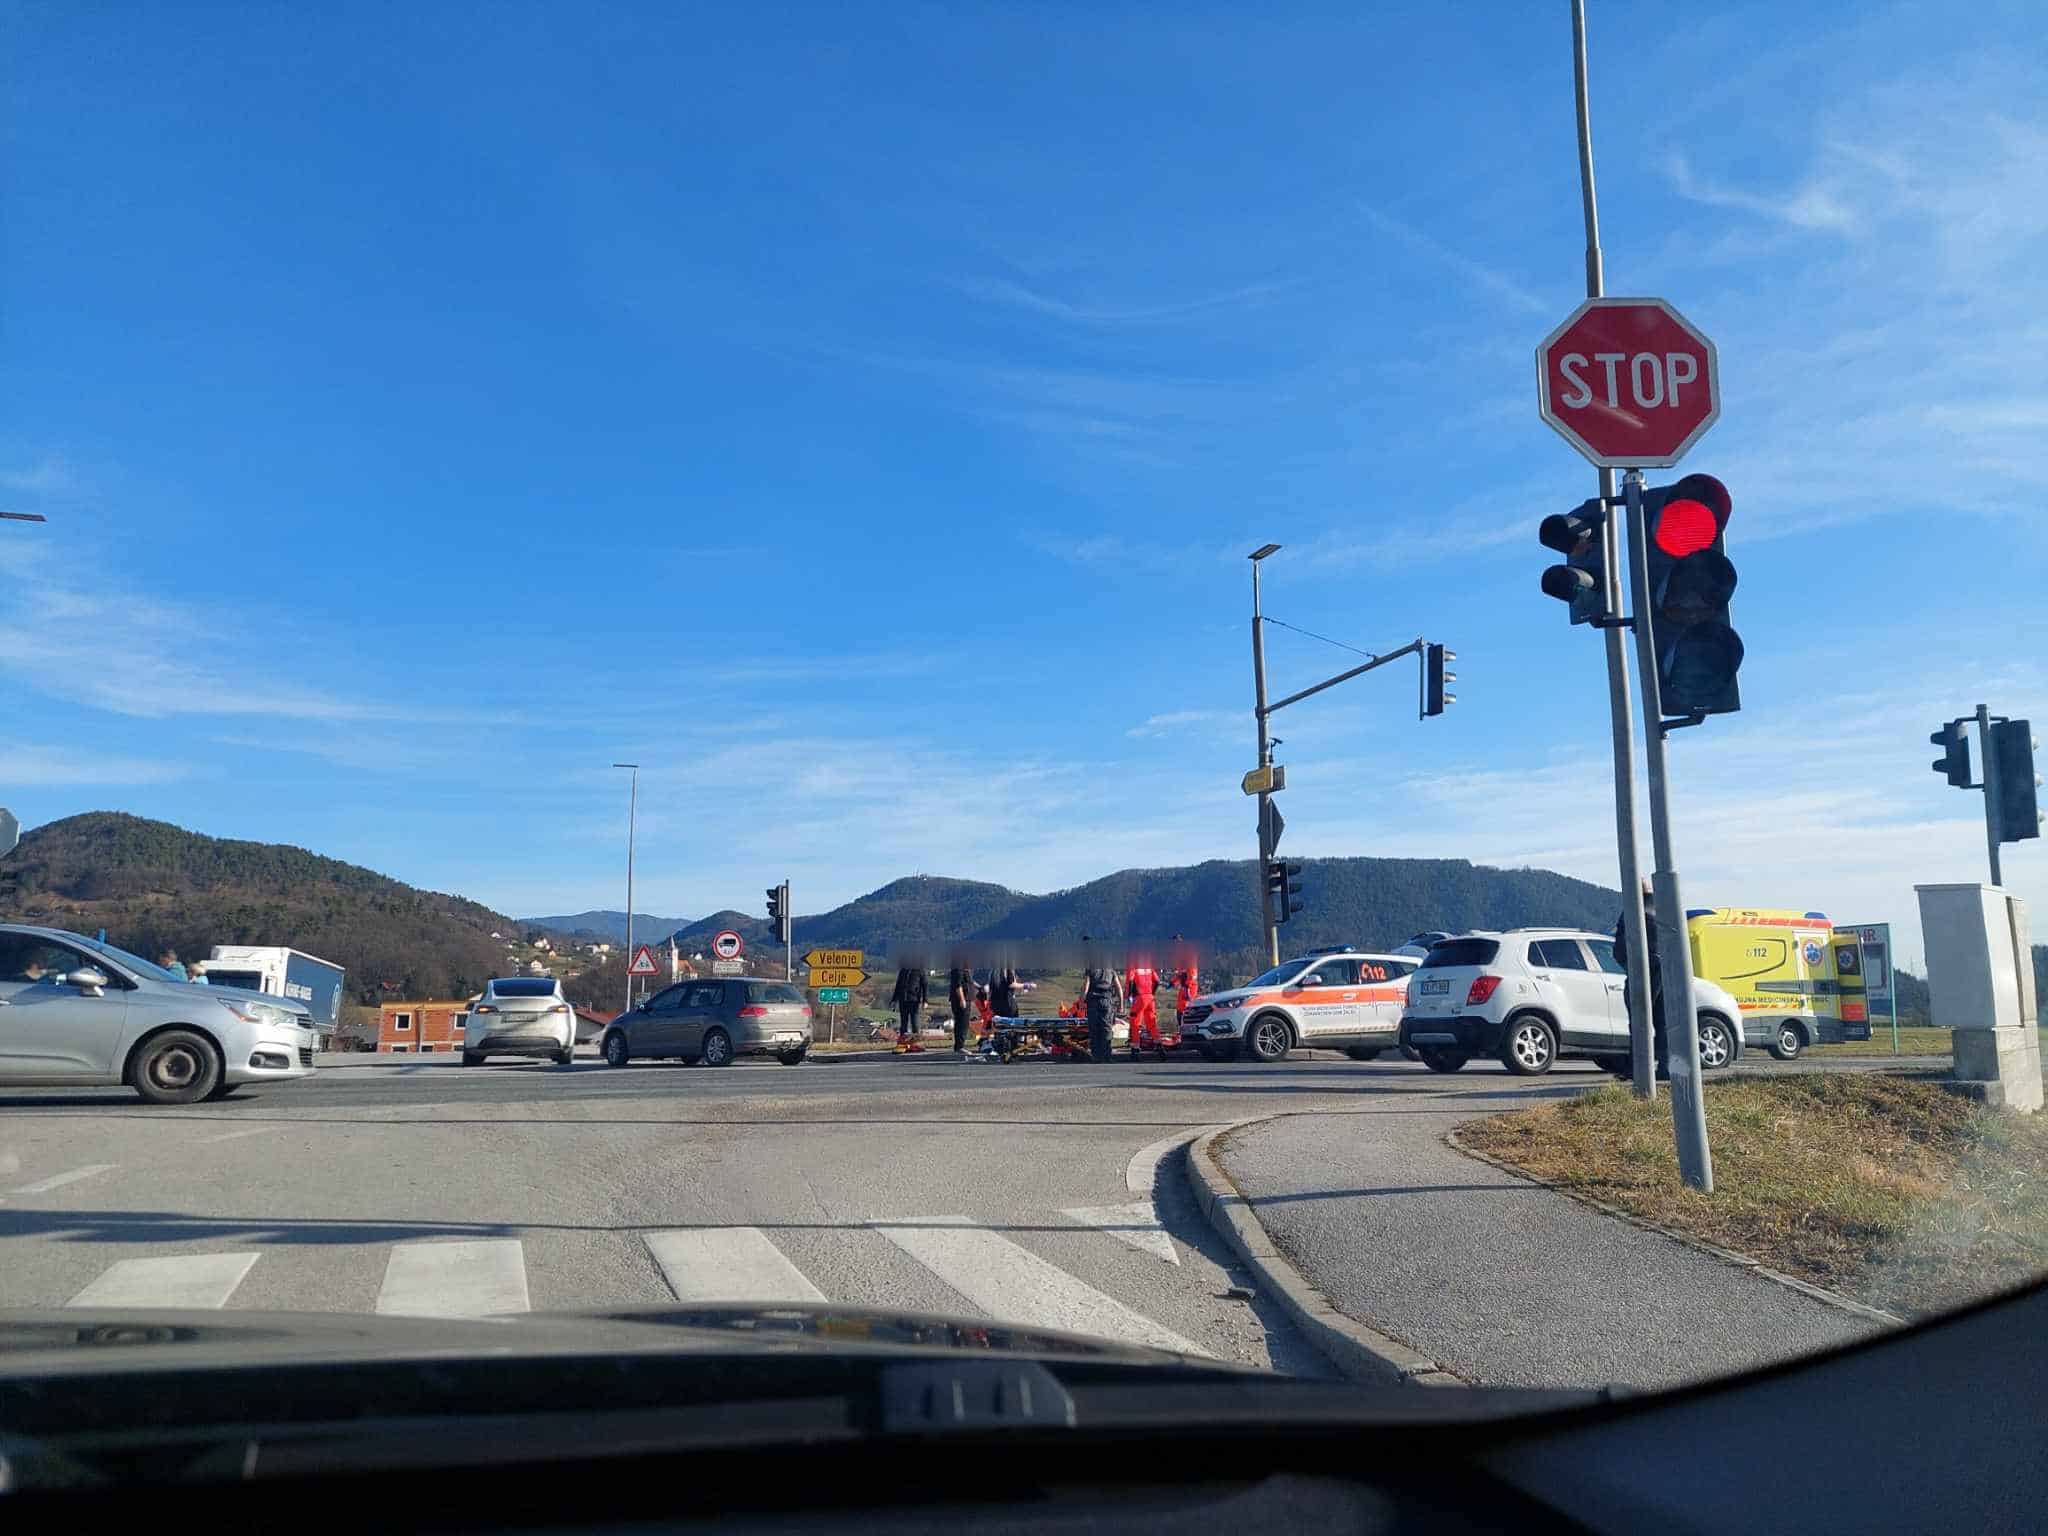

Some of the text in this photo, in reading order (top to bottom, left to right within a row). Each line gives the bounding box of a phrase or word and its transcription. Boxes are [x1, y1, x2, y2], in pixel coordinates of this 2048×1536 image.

[1559, 351, 1698, 409] STOP
[820, 951, 857, 966] Velenje
[1753, 948, 1767, 957] 112
[821, 970, 847, 986] Celje
[1368, 966, 1387, 980] 112
